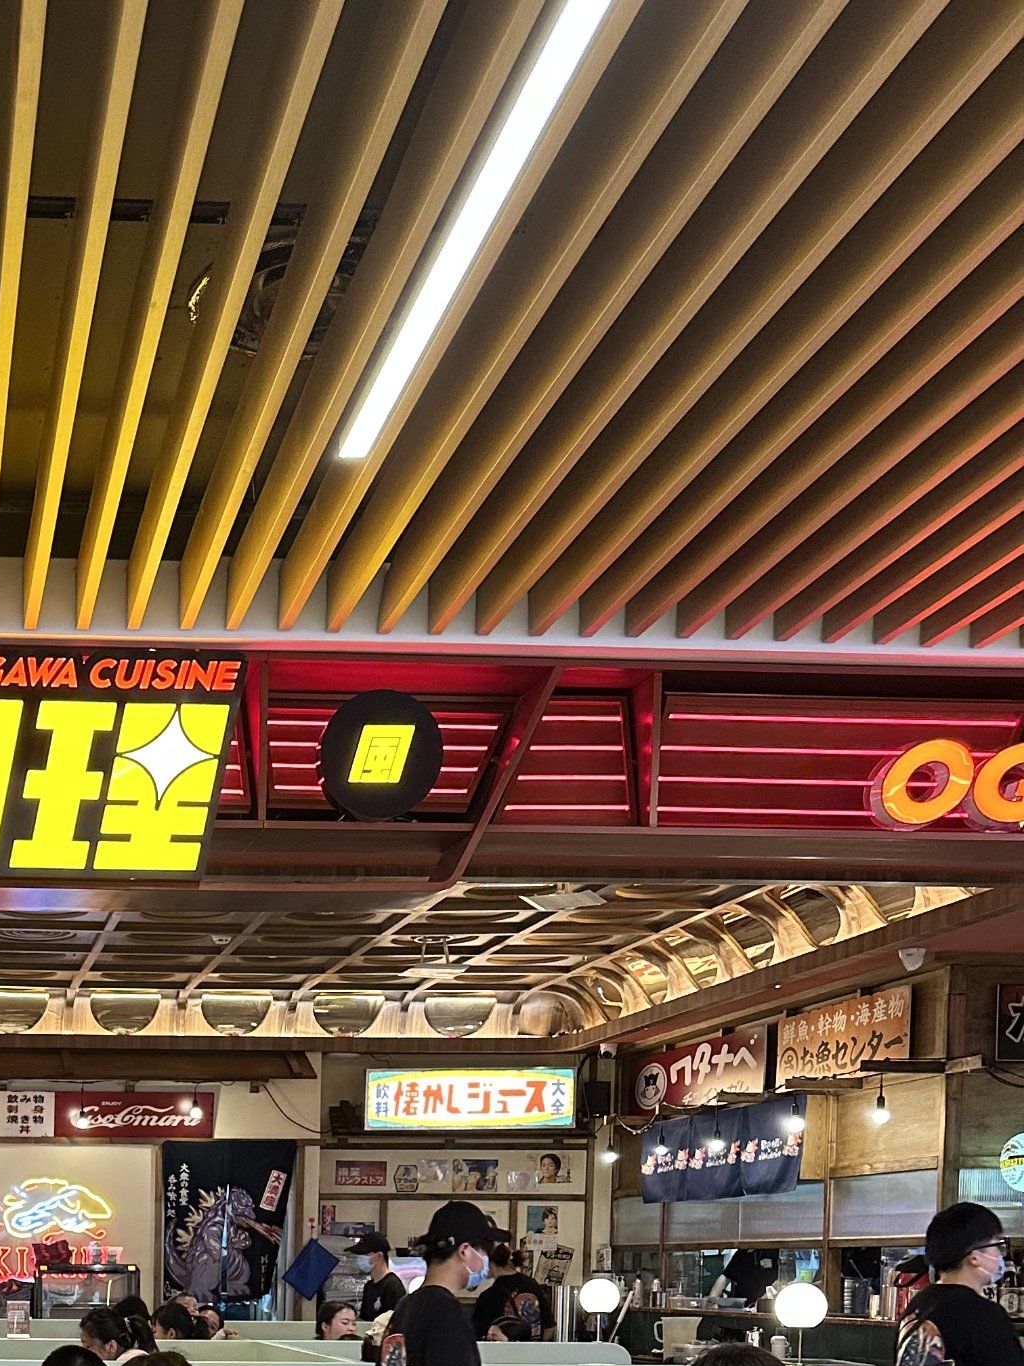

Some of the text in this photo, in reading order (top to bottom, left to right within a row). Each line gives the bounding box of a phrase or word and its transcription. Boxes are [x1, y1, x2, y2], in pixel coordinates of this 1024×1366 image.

[89, 659, 239, 691] CUISINE
[670, 1034, 758, 1087] ワタナベ
[6, 1094, 45, 1104] 飲み物
[375, 1083, 389, 1117] 飲料
[394, 1080, 548, 1117] 懐かしジュース
[550, 1079, 565, 1116] 大全
